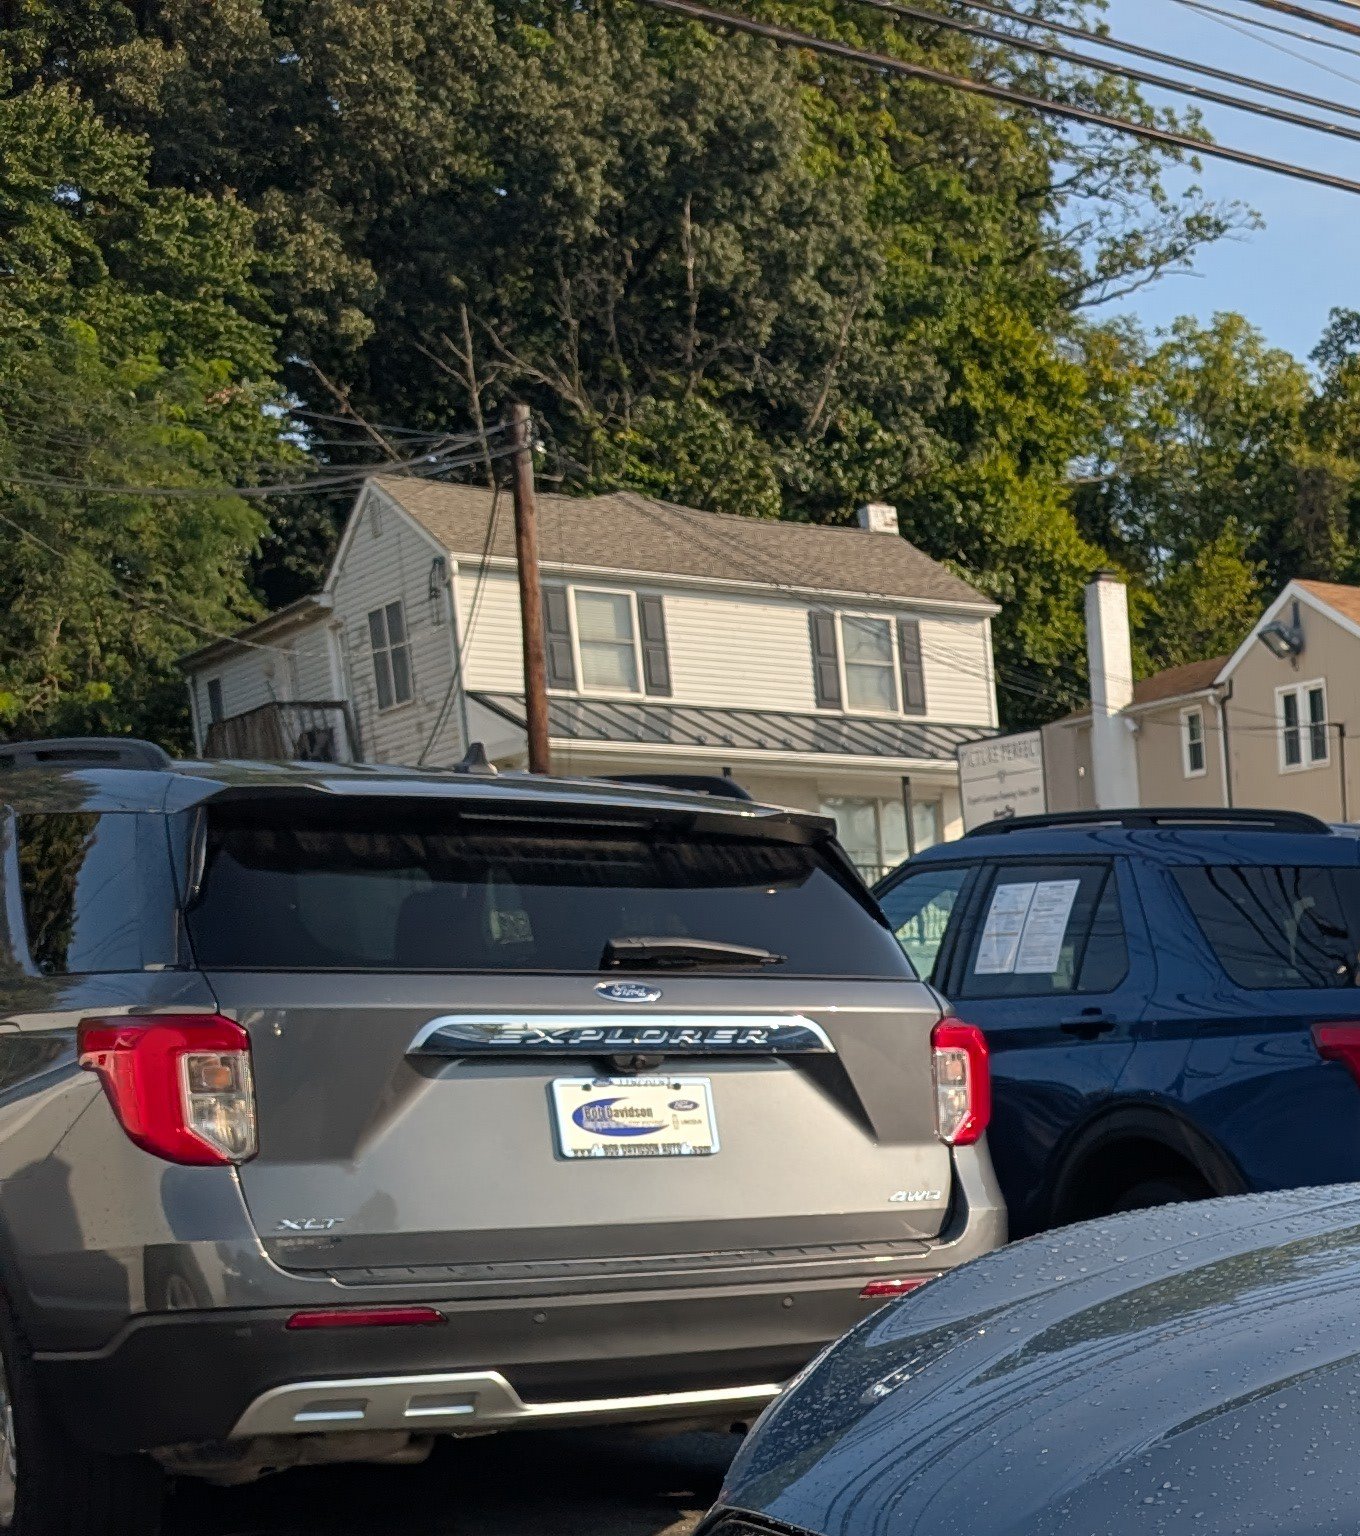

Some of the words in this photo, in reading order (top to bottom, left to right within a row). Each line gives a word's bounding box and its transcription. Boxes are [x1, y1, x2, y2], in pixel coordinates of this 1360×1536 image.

[611, 984, 648, 998] Ford
[488, 1028, 769, 1045] EXPLORER
[584, 1105, 607, 1121] Bob
[607, 1105, 654, 1120] Davidson
[887, 1190, 942, 1202] 4WD
[275, 1217, 345, 1231] XLT
